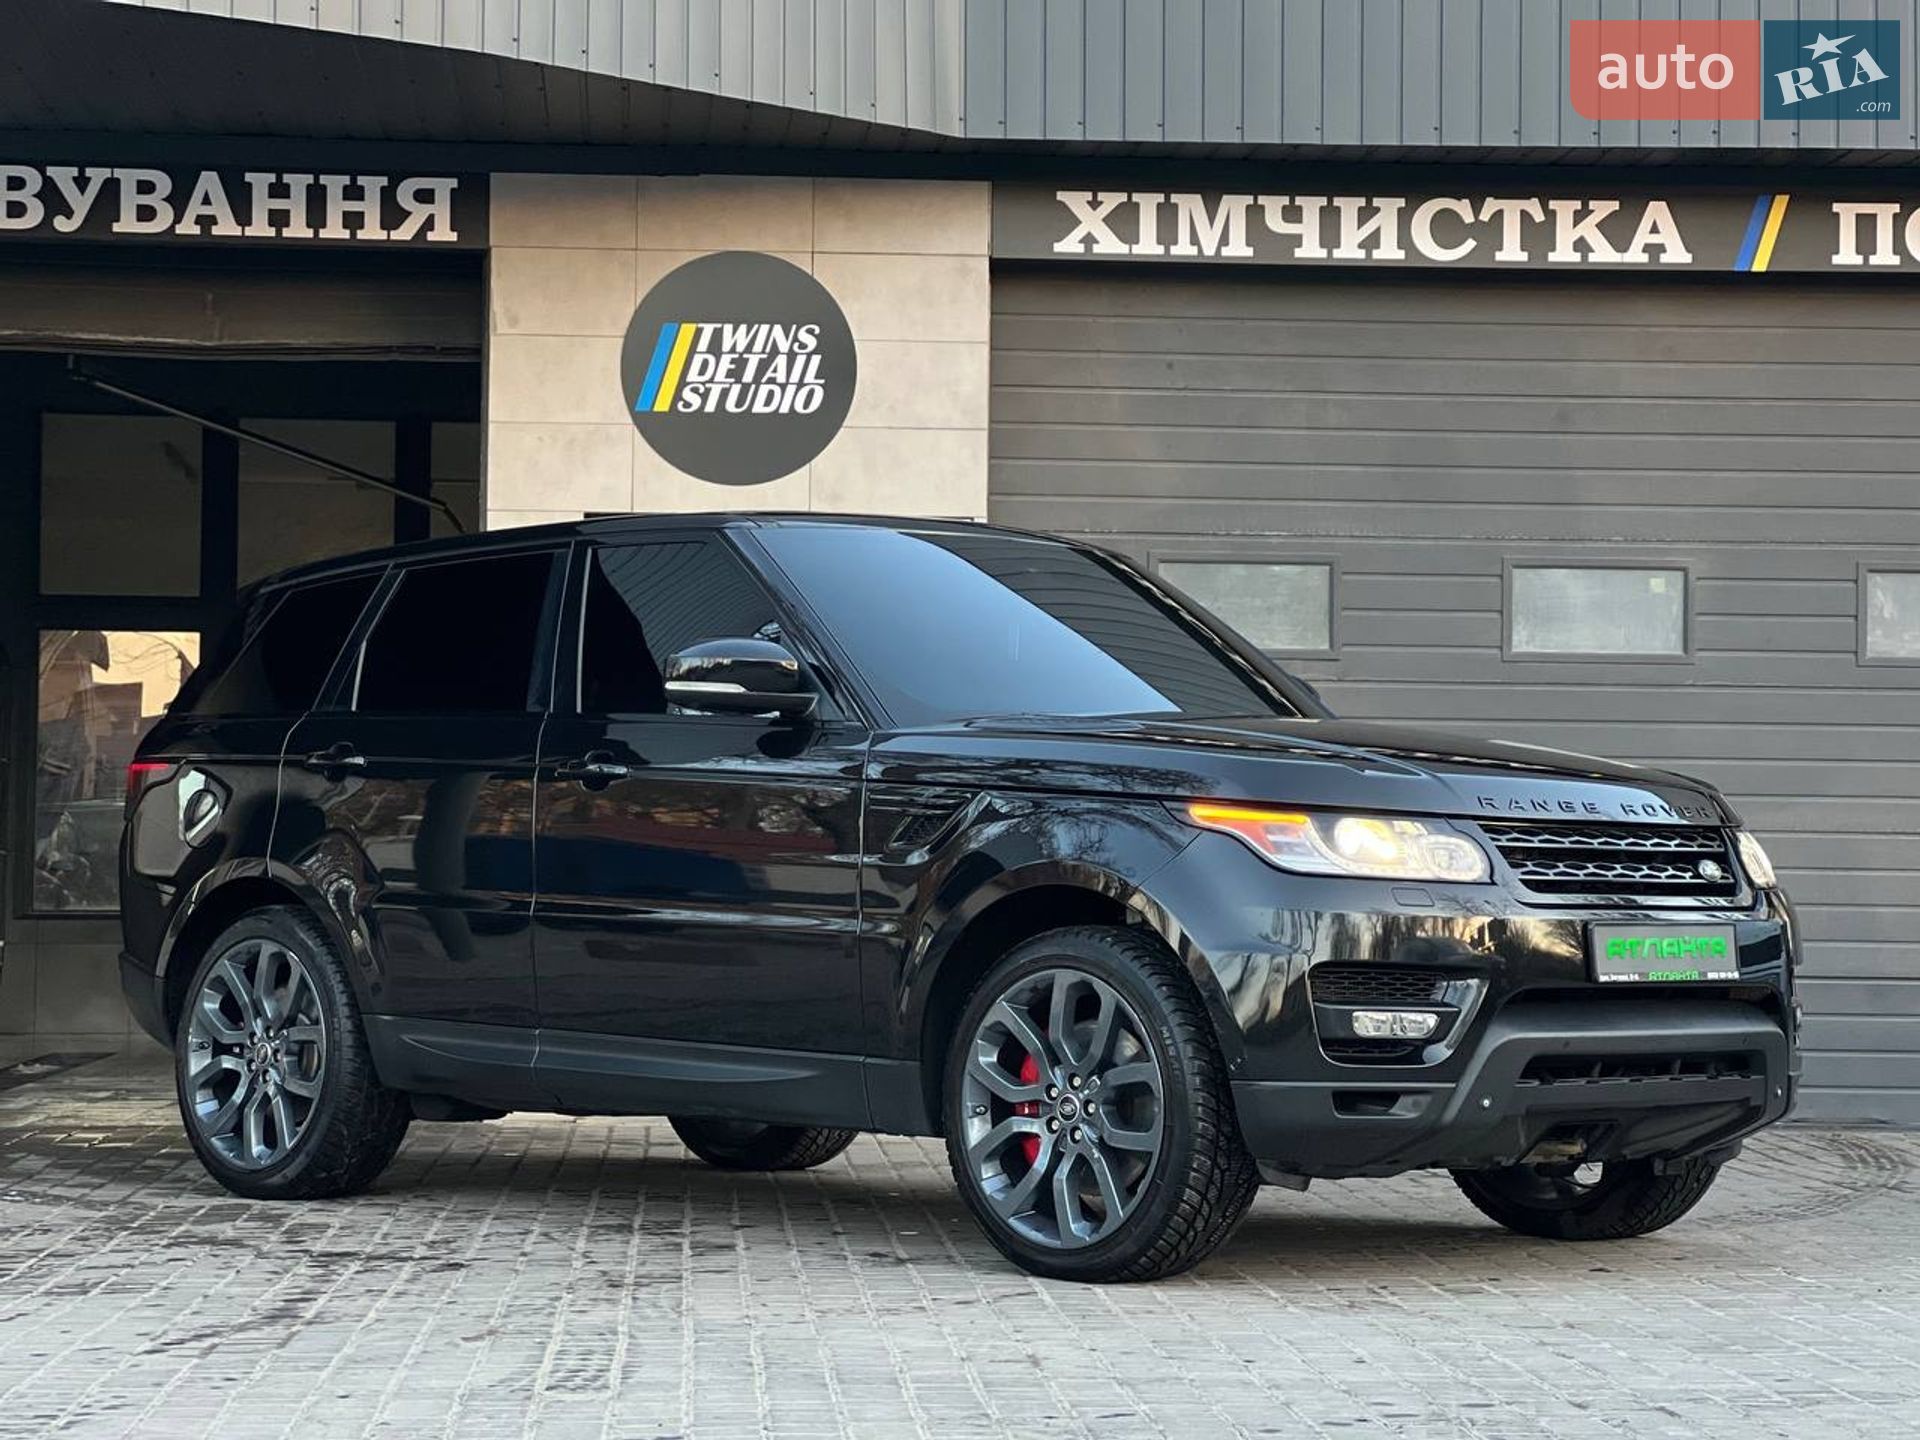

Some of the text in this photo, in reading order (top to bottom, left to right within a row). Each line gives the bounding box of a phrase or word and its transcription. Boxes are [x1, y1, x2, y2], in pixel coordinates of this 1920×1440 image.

[0, 165, 459, 242] ВУВАННЯ
[1052, 190, 1694, 266] ХІМЧИСТКА
[1831, 202, 1920, 266] П
[695, 322, 821, 354] TWINS
[685, 353, 826, 384] DETAIL
[676, 382, 825, 414] STUDIO
[1477, 794, 1715, 820] RANGE ROVER
